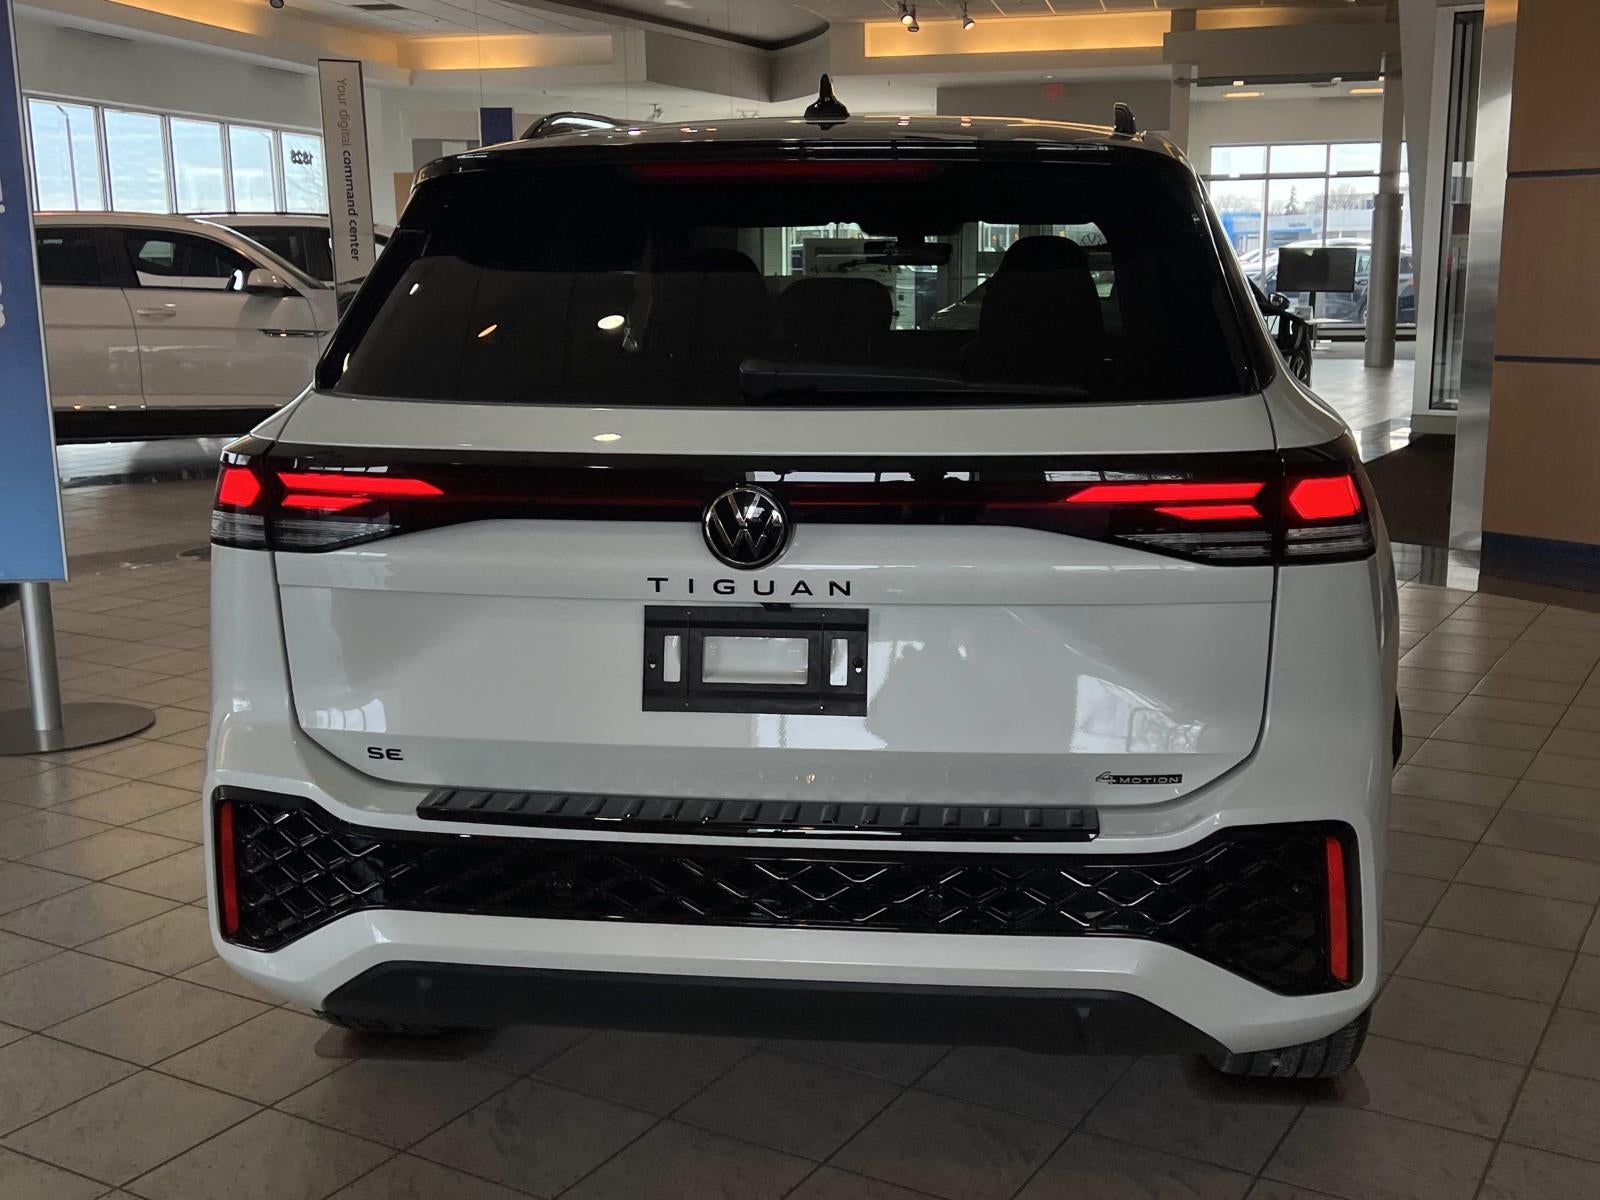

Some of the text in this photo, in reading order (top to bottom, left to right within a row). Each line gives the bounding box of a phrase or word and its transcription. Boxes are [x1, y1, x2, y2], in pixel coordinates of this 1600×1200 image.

[336, 78, 360, 262] Your digital command center
[647, 577, 851, 597] TIGUAN
[367, 746, 404, 761] SE
